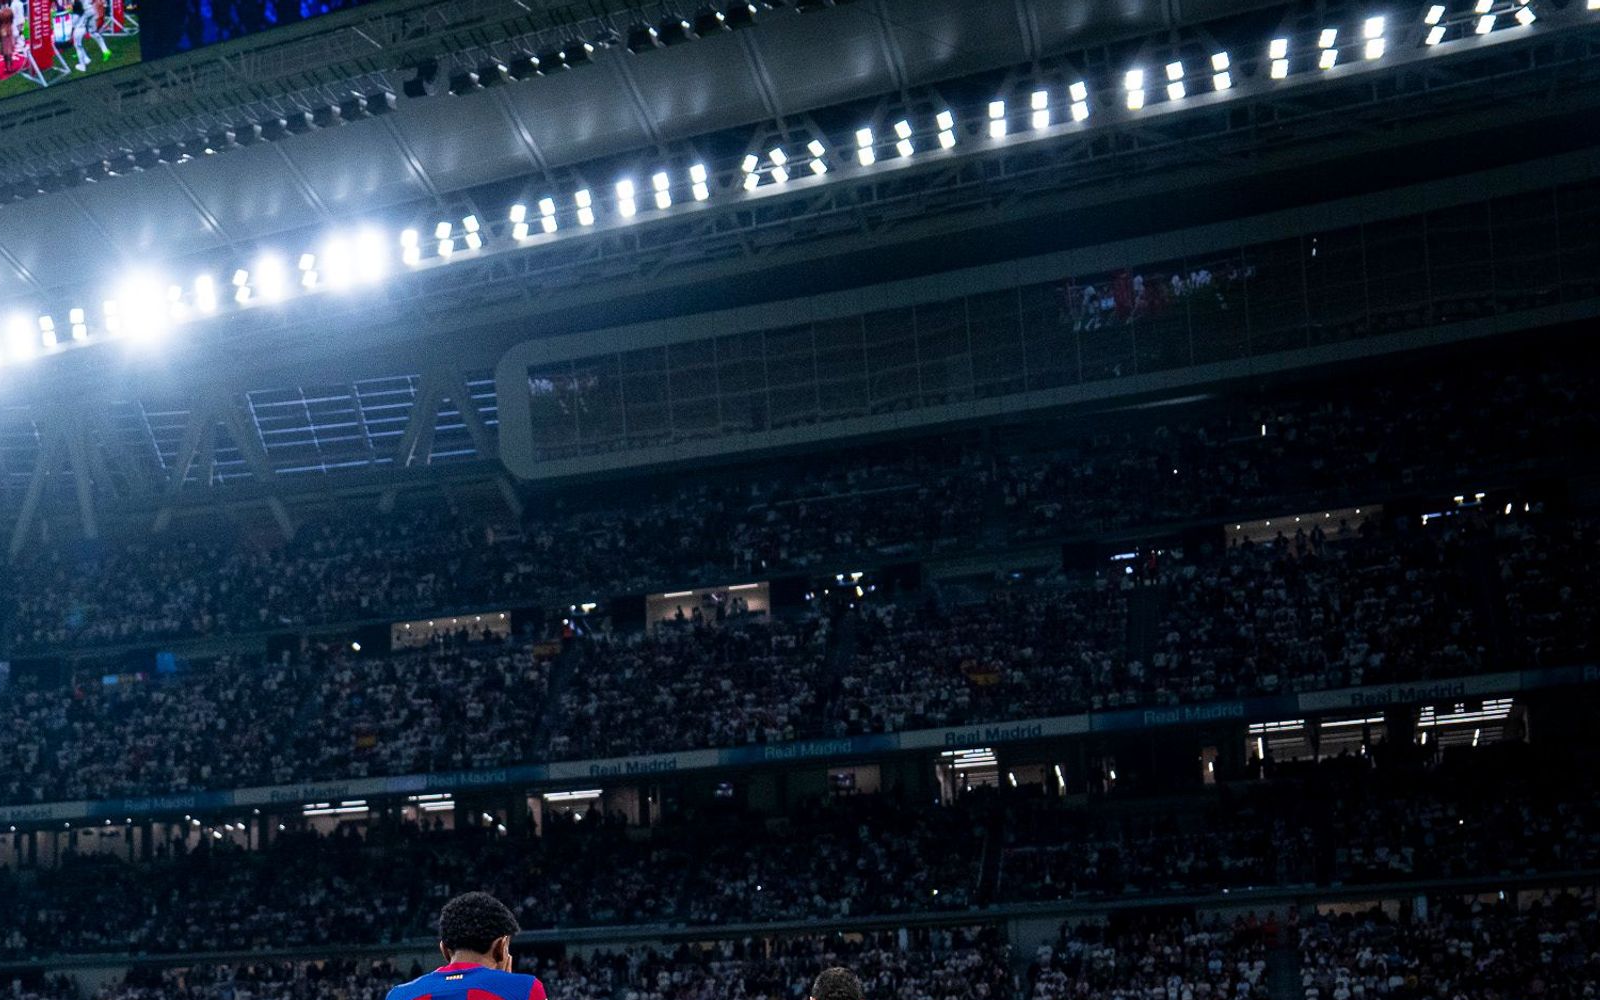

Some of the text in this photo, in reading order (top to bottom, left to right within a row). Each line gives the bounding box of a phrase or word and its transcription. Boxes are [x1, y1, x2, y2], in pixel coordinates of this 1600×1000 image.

[1350, 681, 1466, 708] Real Madrid
[1143, 702, 1245, 727] Real Madrid
[944, 723, 1043, 746] Real Madrid
[589, 757, 677, 777] Real Madrid
